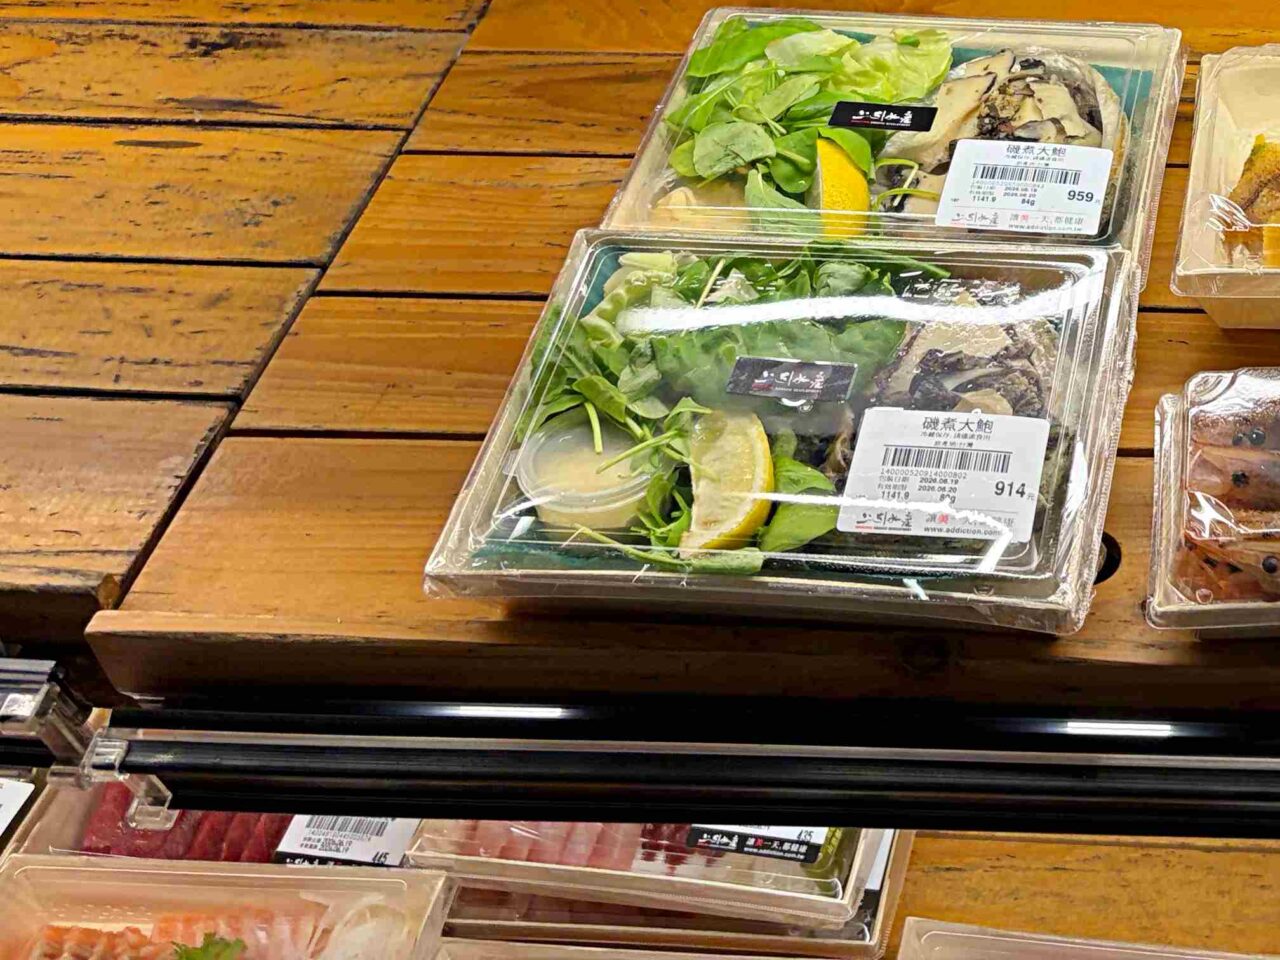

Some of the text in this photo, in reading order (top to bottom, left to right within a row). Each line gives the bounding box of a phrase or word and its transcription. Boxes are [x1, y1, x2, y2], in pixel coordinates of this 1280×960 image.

[1067, 190, 1095, 203] 959
[922, 416, 994, 434] 磯煮大鮑
[917, 485, 958, 494] 2026.06.20
[994, 480, 1026, 498] 914
[881, 491, 910, 500] 1141.9
[923, 526, 1003, 537] www.addiction.com
